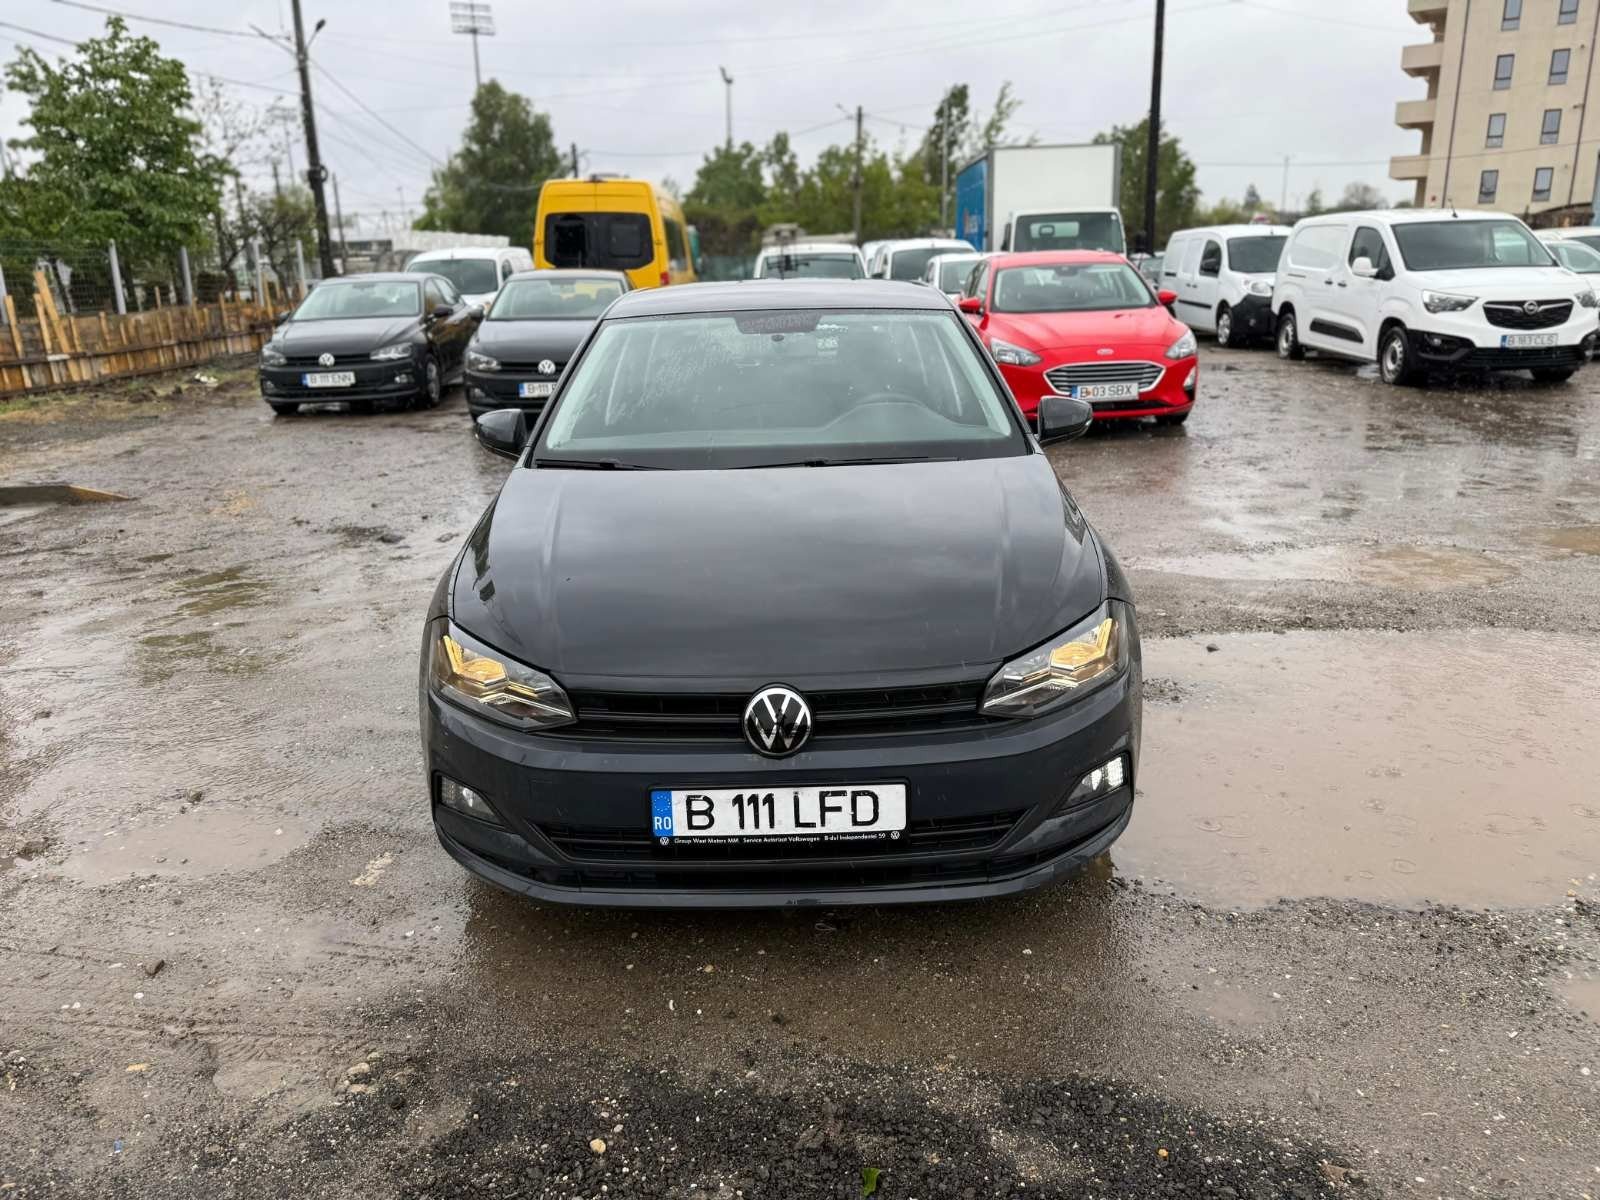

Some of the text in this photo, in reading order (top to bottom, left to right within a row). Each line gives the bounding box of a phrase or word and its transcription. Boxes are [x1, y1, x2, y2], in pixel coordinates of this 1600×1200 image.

[1092, 386, 1106, 397] 03
[1108, 384, 1132, 396] SBX
[685, 789, 880, 831] B 111 LFD
[654, 816, 672, 830] RO
[674, 837, 692, 845] Group
